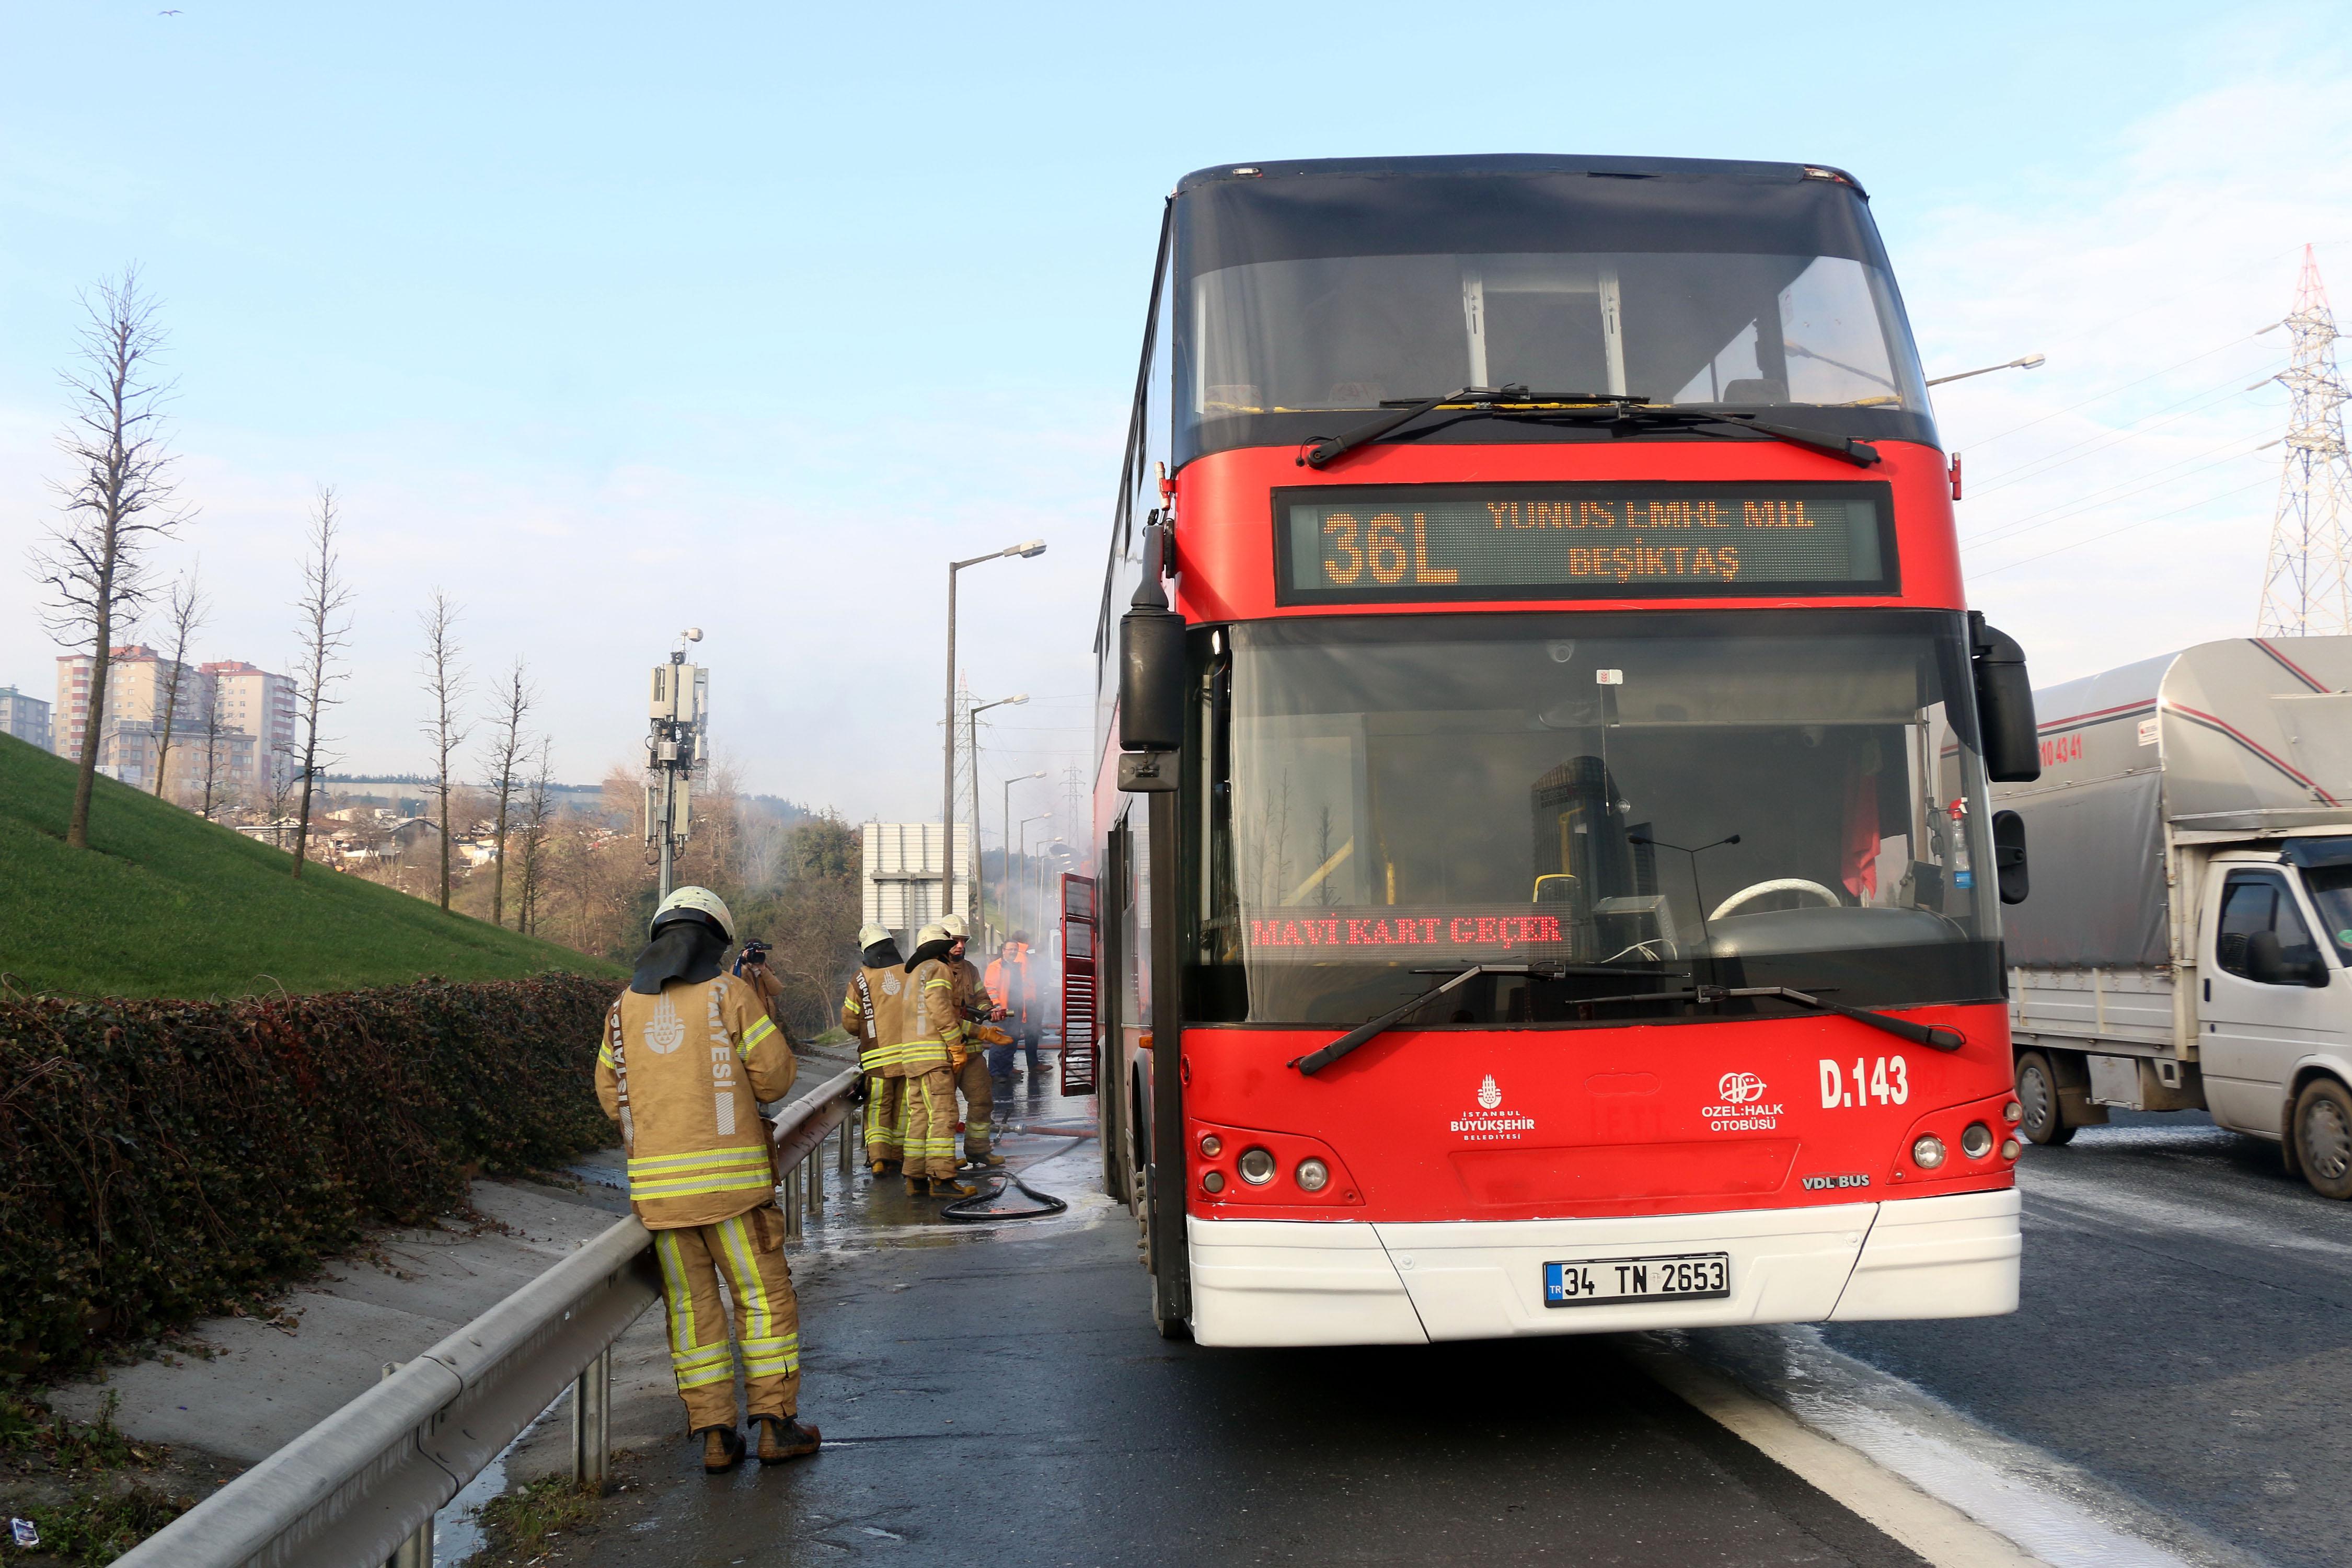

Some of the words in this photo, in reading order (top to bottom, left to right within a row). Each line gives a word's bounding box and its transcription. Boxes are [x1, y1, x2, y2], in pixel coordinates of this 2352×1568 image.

[1488, 501, 1617, 529] YUNUS
[1626, 501, 1729, 528] EMRE
[1324, 511, 1458, 584] 36L
[1569, 537, 1739, 583] BEŞİKTAŞ
[2056, 737, 2069, 764] 43
[2071, 734, 2082, 760] 41
[1251, 913, 1339, 946] MAVİ
[1345, 918, 1442, 944] KART
[1449, 916, 1563, 949] GEÇER
[856, 972, 874, 1019] İSTANBUL
[1819, 1055, 1908, 1109] D.143
[1450, 1116, 1535, 1133] BÜYÜKŞEHİR
[1711, 1116, 1776, 1131] OTOBÜSÜ
[1802, 1177, 1835, 1190] VDL
[1839, 1175, 1870, 1187] BUS
[1549, 1285, 1561, 1294] TR
[1565, 1267, 1595, 1296] 34
[1615, 1265, 1647, 1294] TN
[1662, 1262, 1724, 1292] 2653
